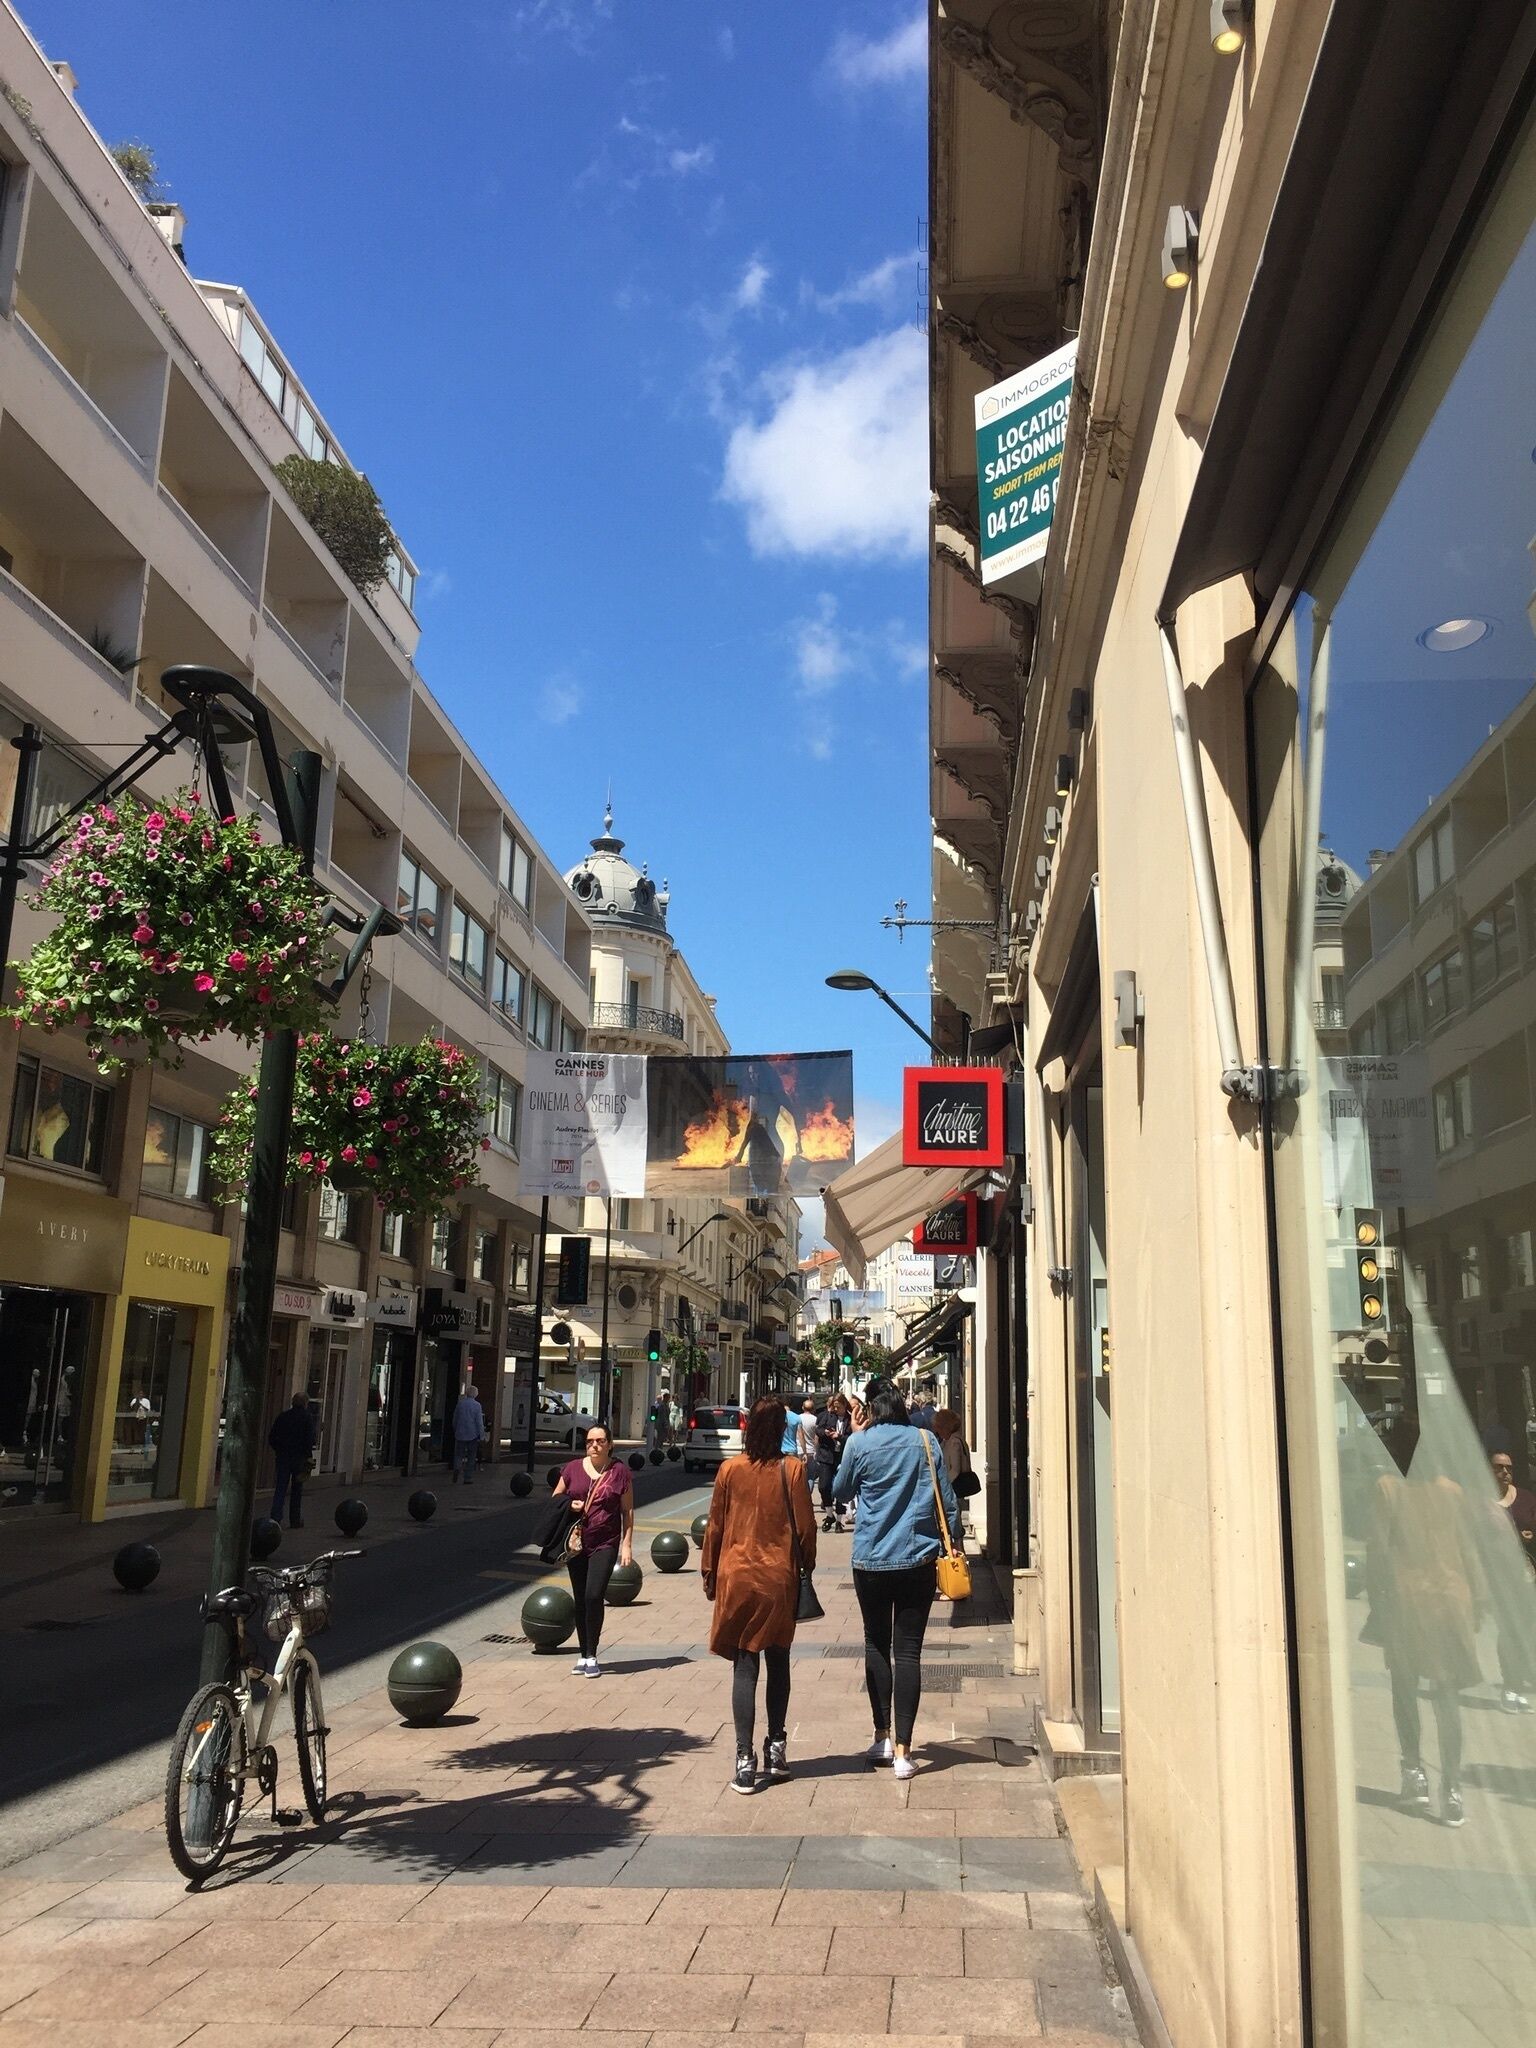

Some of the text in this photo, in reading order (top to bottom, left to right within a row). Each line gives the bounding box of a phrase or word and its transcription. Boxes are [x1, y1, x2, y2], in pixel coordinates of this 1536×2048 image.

[993, 475, 1022, 499] SHORT
[1024, 461, 1047, 484] TERM
[987, 507, 1007, 538] 04
[1009, 496, 1028, 529] 22
[1031, 484, 1050, 515] 46
[555, 1058, 605, 1070] CANNES
[586, 1070, 605, 1078] MUR
[530, 1090, 627, 1114] CINEMA & SERIES
[924, 1098, 983, 1136] Christine
[925, 1130, 978, 1143] LAURE
[37, 1220, 88, 1243] AVERY
[926, 1231, 961, 1240] LAURE
[379, 1305, 406, 1315] Aubade
[432, 1314, 456, 1325] JOYA
